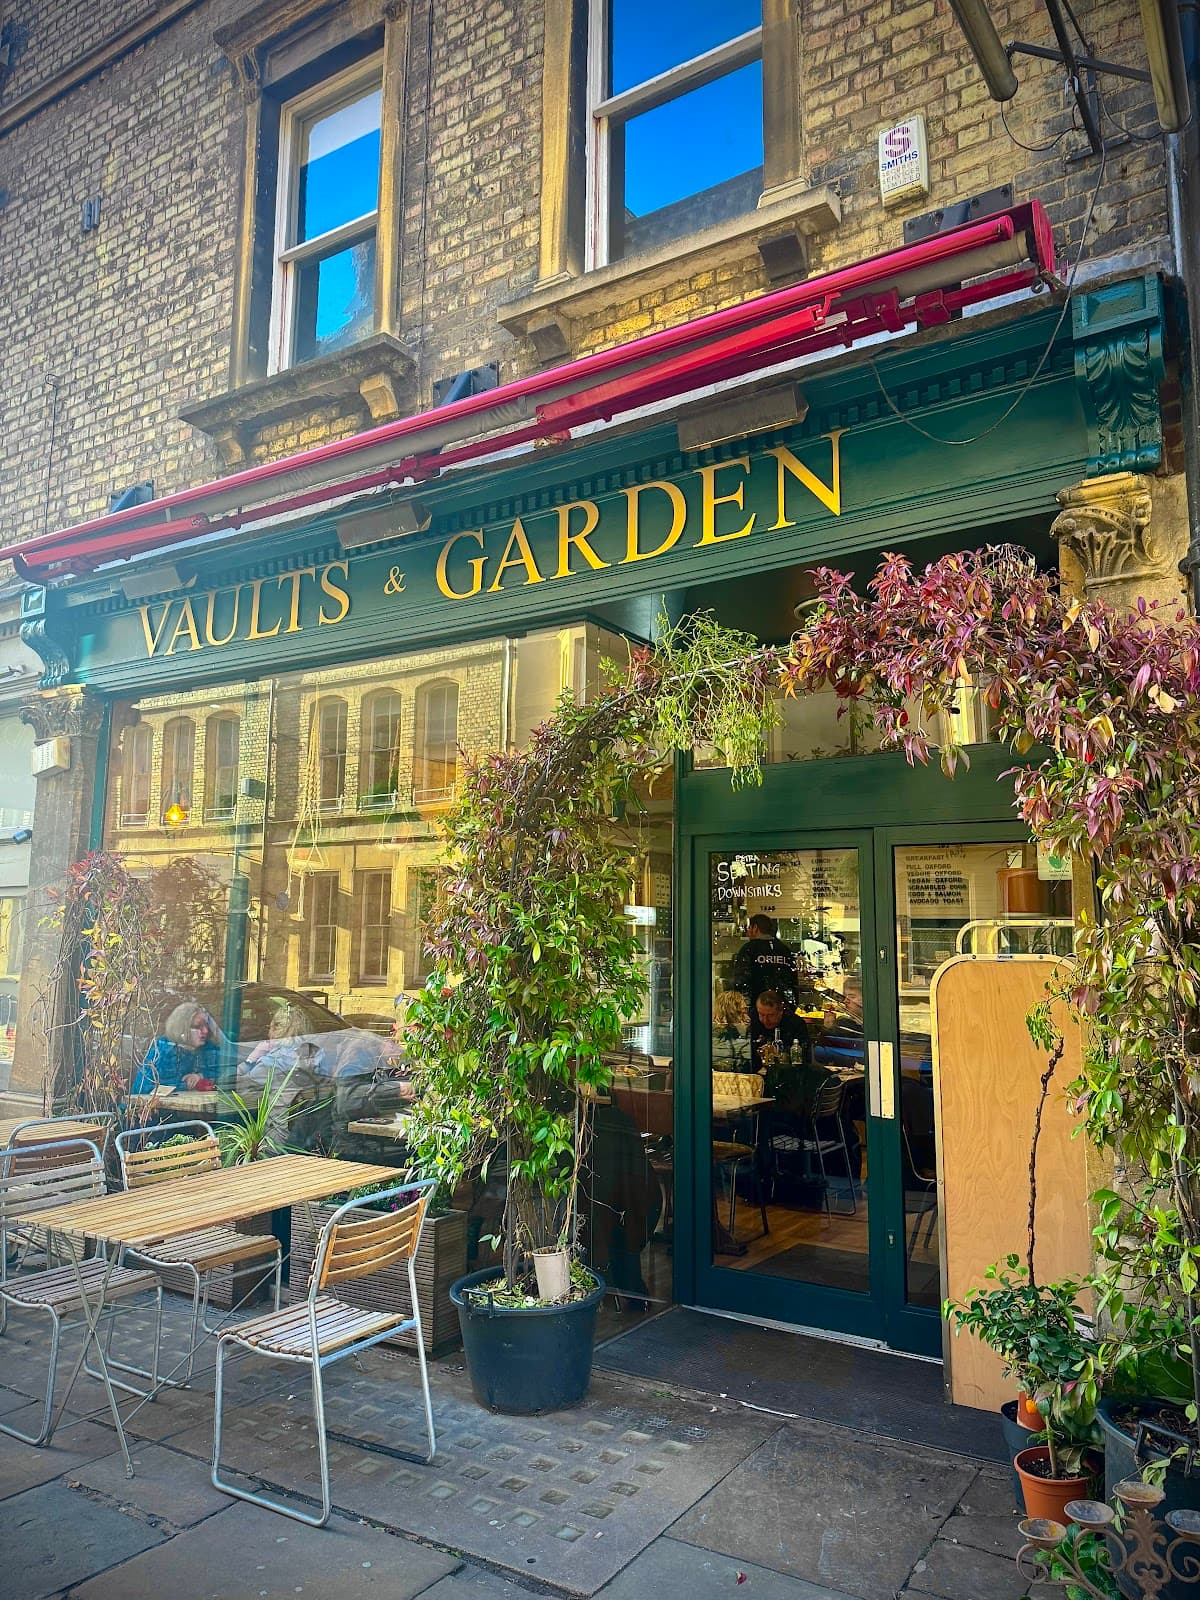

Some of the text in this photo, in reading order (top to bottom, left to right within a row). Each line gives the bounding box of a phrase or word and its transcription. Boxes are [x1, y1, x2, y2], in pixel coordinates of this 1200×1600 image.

[881, 150, 918, 171] SMITHS
[882, 160, 919, 177] SECURITY
[882, 166, 920, 185] SERVICES
[883, 173, 921, 192] LIMITED
[139, 428, 850, 658] VAULTS & GARDEN
[735, 854, 760, 863] EXTRA
[905, 854, 945, 862] BREAKFAST
[717, 861, 781, 882] SEATING
[717, 884, 783, 900] DOWNSTAIRS
[757, 955, 788, 965] ORIEL
